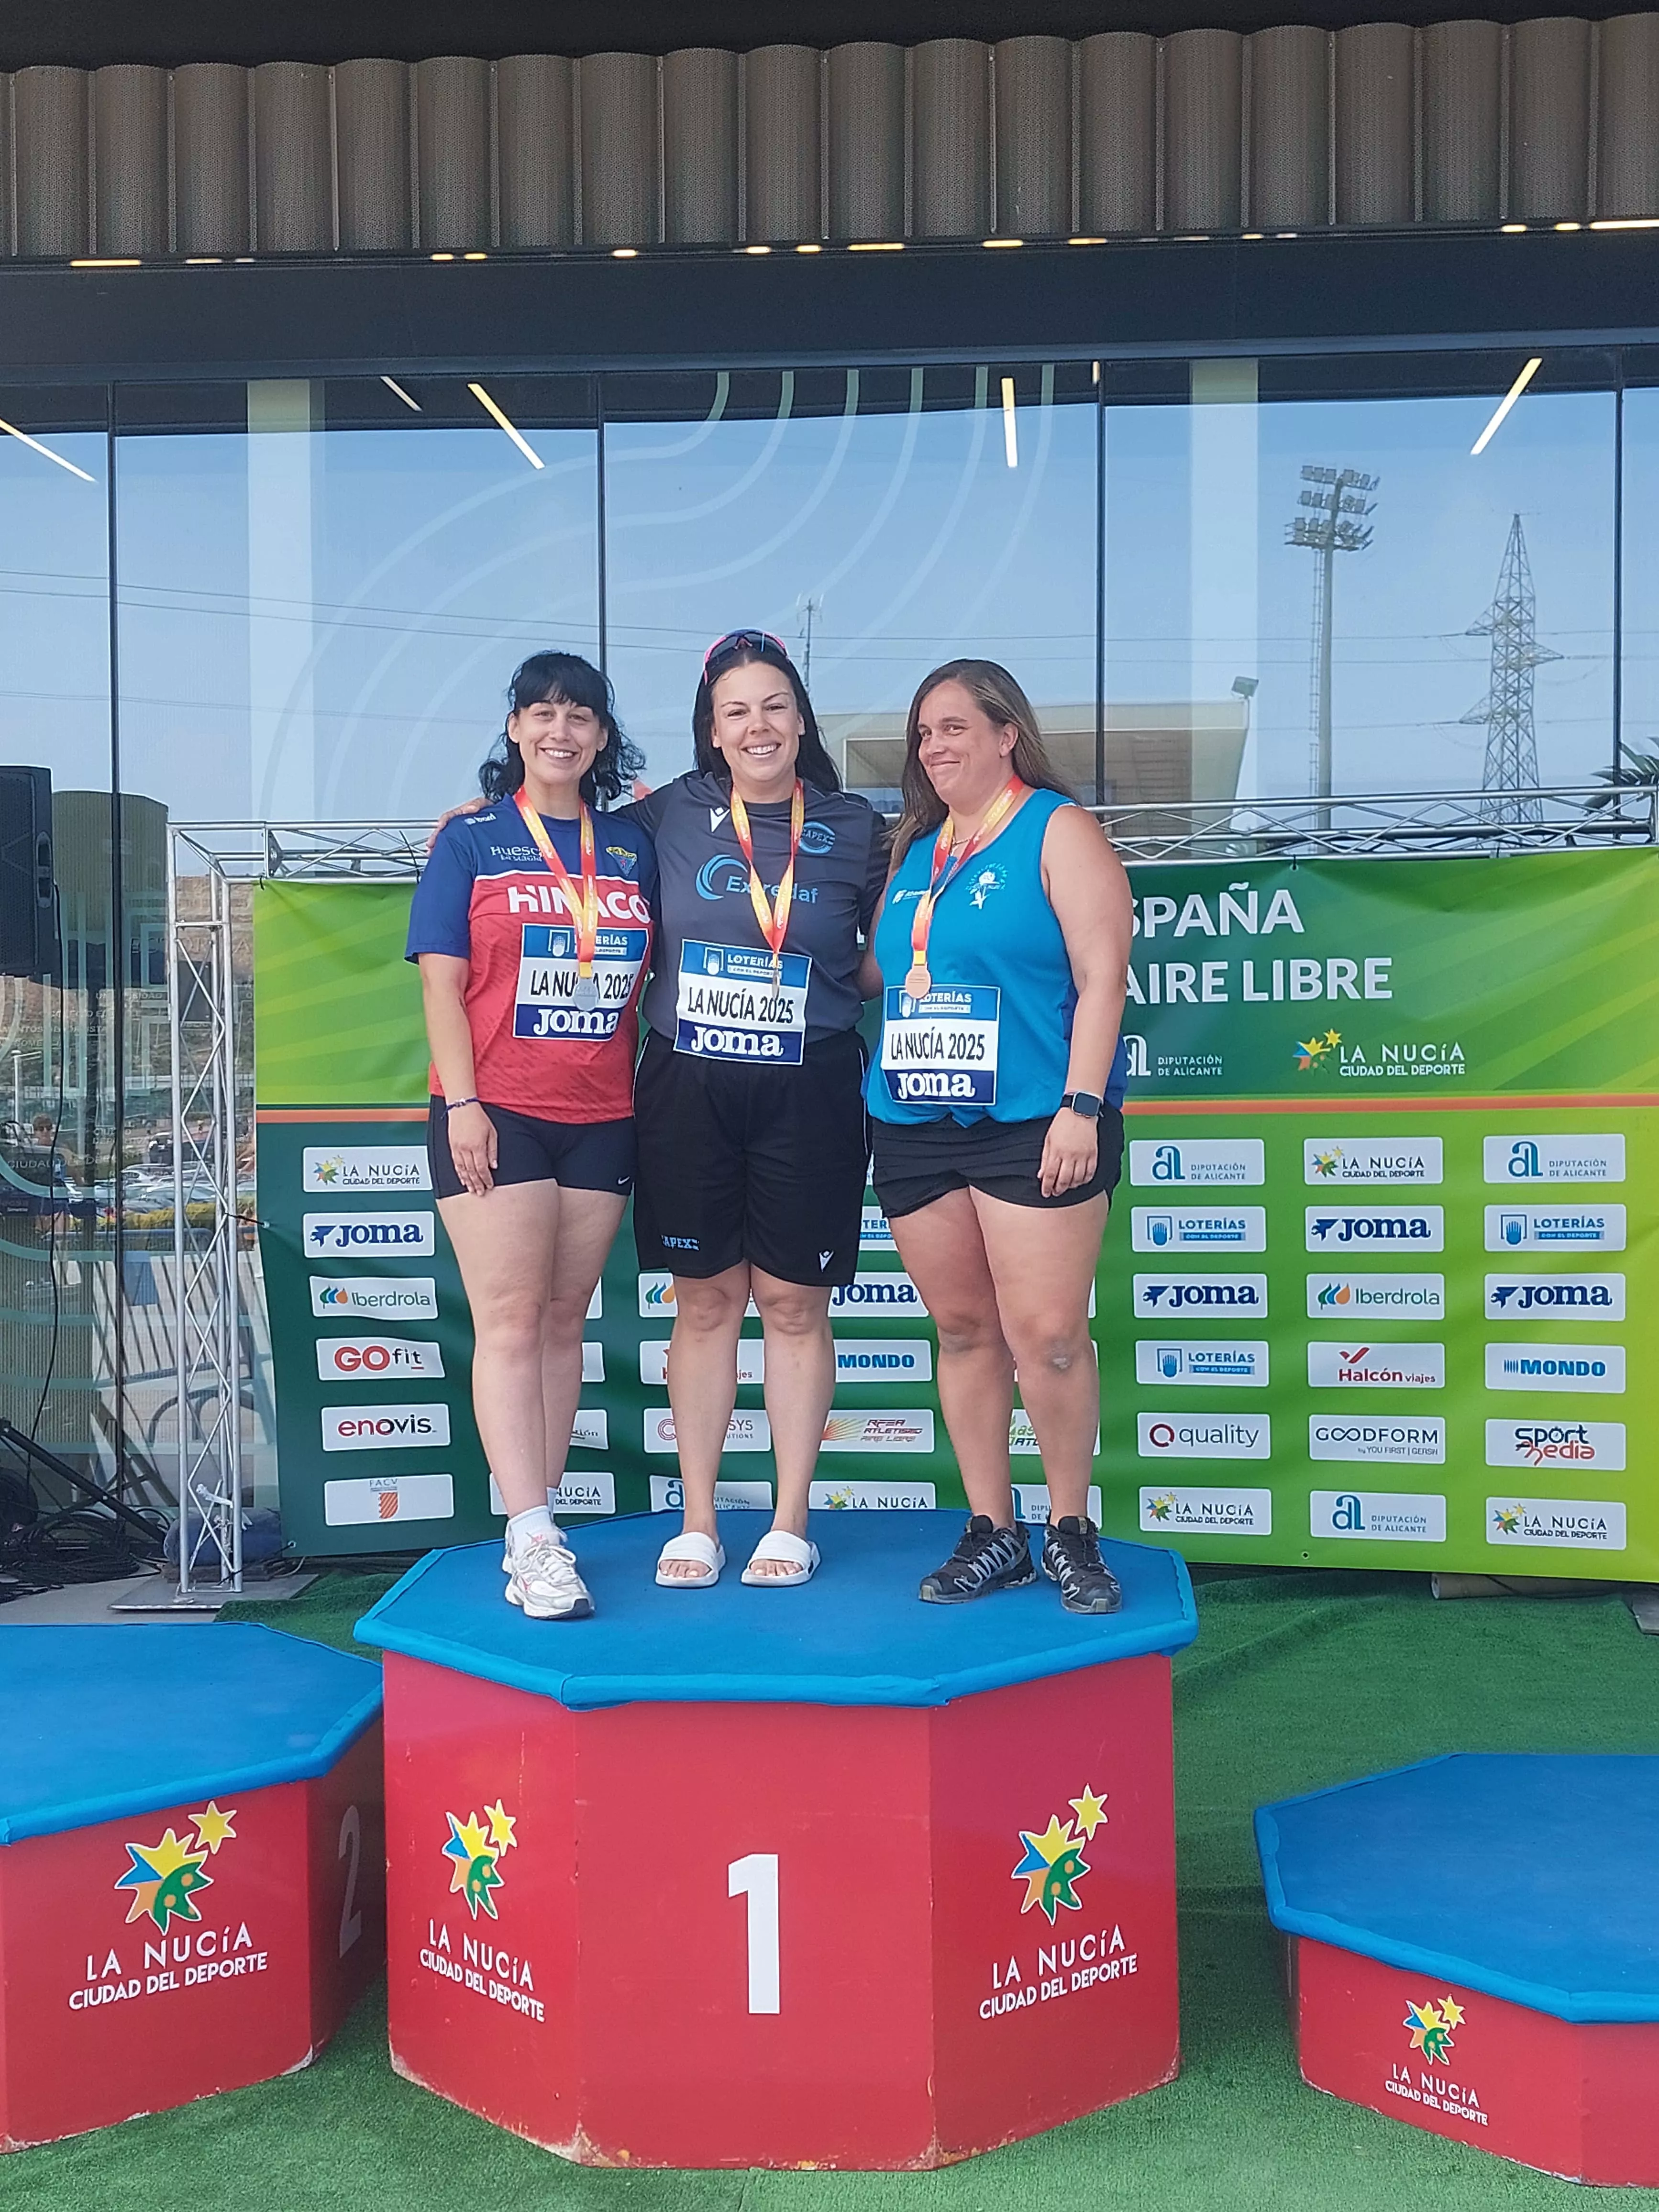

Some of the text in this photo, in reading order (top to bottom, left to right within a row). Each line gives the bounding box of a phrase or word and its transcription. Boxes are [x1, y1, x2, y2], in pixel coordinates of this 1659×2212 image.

[726, 875, 818, 903] Exreaf
[531, 970, 549, 996] LA
[604, 974, 634, 999] 2025
[1243, 958, 1393, 1001] LIBRE
[688, 987, 794, 1023] LA NUCÍA 2025
[891, 1027, 985, 1061] LA NUCÍA 2025
[1158, 1054, 1223, 1065] DIPUTACIÓN
[1340, 1046, 1364, 1063] LA
[1158, 1067, 1223, 1076] DE ALICANTE
[1340, 1064, 1465, 1076] CIUDAD DEL DEPORTE
[343, 1165, 358, 1176] LA
[1343, 1160, 1359, 1169] LA
[1179, 1218, 1246, 1230] LOTERÍAS
[1534, 1216, 1604, 1228] LOTERÍAS
[661, 1235, 692, 1249] APEX
[352, 1291, 430, 1306] Iberdrola
[1355, 1288, 1440, 1305] Iberdrola
[838, 1354, 914, 1368] MONDO
[1188, 1351, 1255, 1363] LOTERÍAS
[1520, 1360, 1605, 1376] MONDO
[1339, 1369, 1436, 1384] Halcón viajes
[338, 1415, 431, 1437] enovis
[1179, 1425, 1259, 1447] quality
[1316, 1427, 1438, 1444] GOODFORM
[852, 1497, 868, 1508] LA
[1176, 1504, 1191, 1516] LA
[1220, 1517, 1254, 1525] DEPORTE
[1371, 1515, 1427, 1524] DIPUTACIÓN
[1524, 1516, 1541, 1528] LA
[1385, 1525, 1427, 1533] ALICANTE
[1571, 1531, 1607, 1539] DEPORTE
[338, 1805, 362, 1959] 2
[429, 1918, 450, 1954] LA
[729, 1854, 780, 2014] 1
[87, 1949, 122, 1981] LA
[993, 1955, 1021, 1990] LA
[69, 1952, 267, 2010] CIUDAD DEL DEPORTE
[420, 1948, 545, 2023] CIUDAD DEL DEPORTE
[979, 1952, 1137, 2019] CIUDAD DEL DEPORTE
[1393, 2063, 1411, 2084] LA
[1385, 2080, 1488, 2126] CIUDAD DEL DEPORTE
